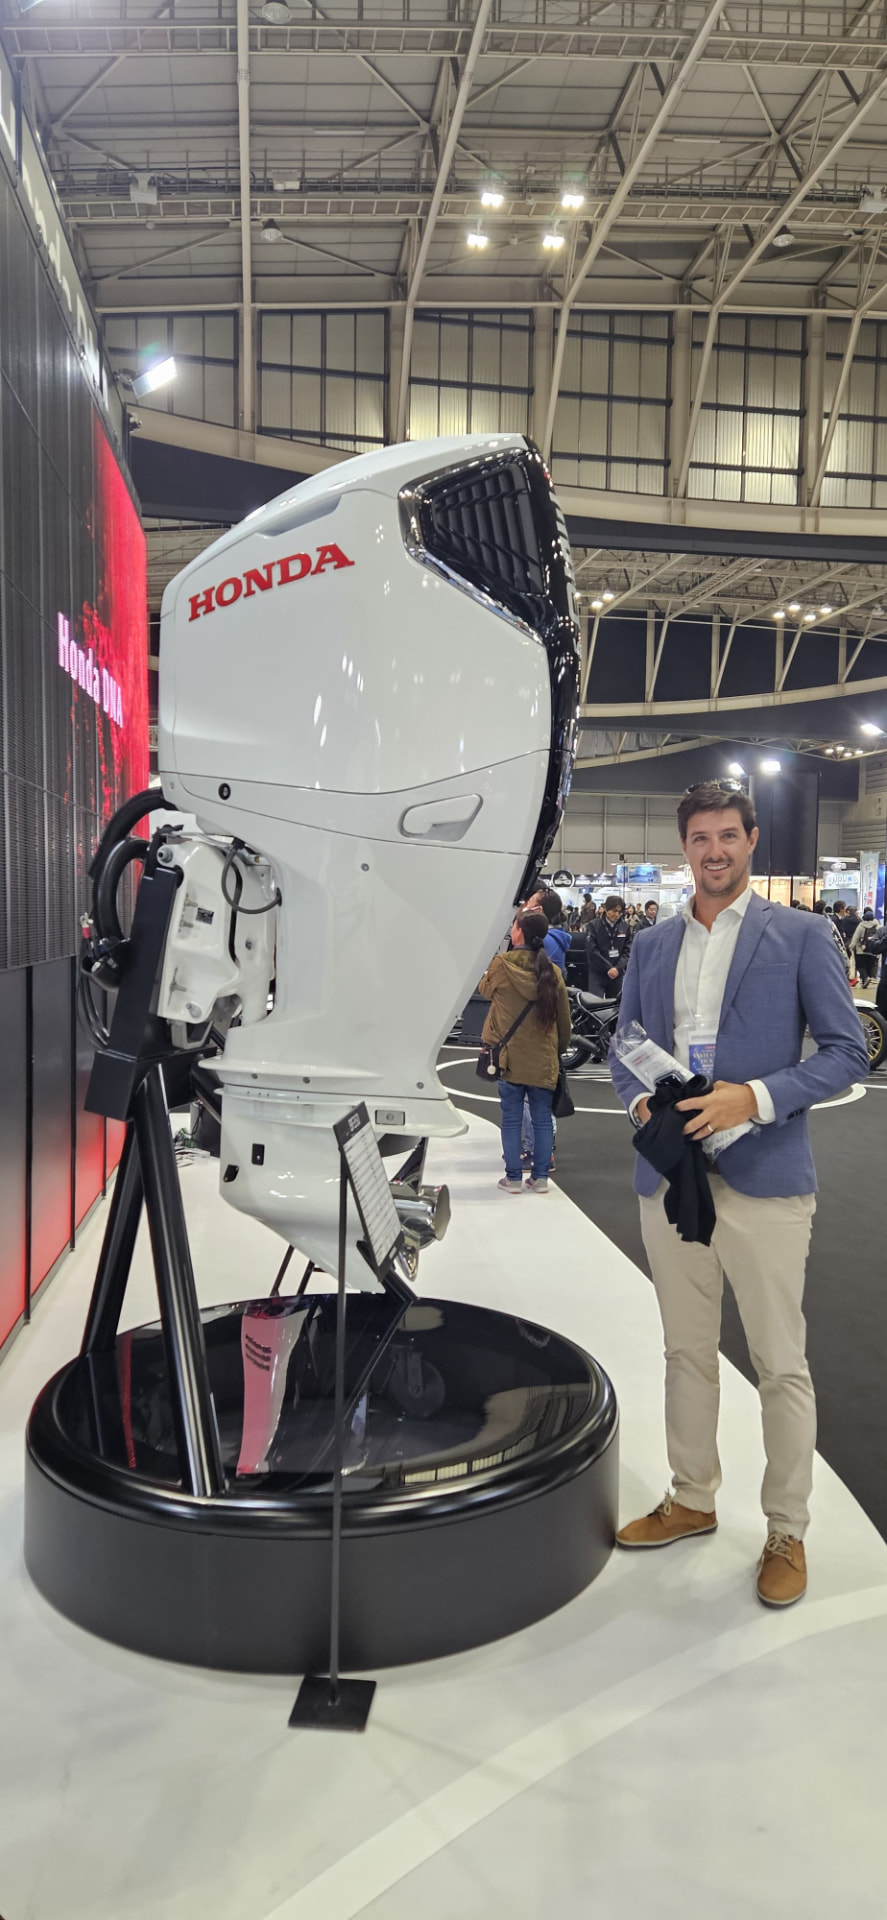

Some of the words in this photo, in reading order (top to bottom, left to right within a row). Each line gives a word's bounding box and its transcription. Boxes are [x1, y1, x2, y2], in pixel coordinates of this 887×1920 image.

[188, 542, 355, 622] HONDA
[58, 611, 100, 704] Honda
[102, 667, 123, 728] DNA
